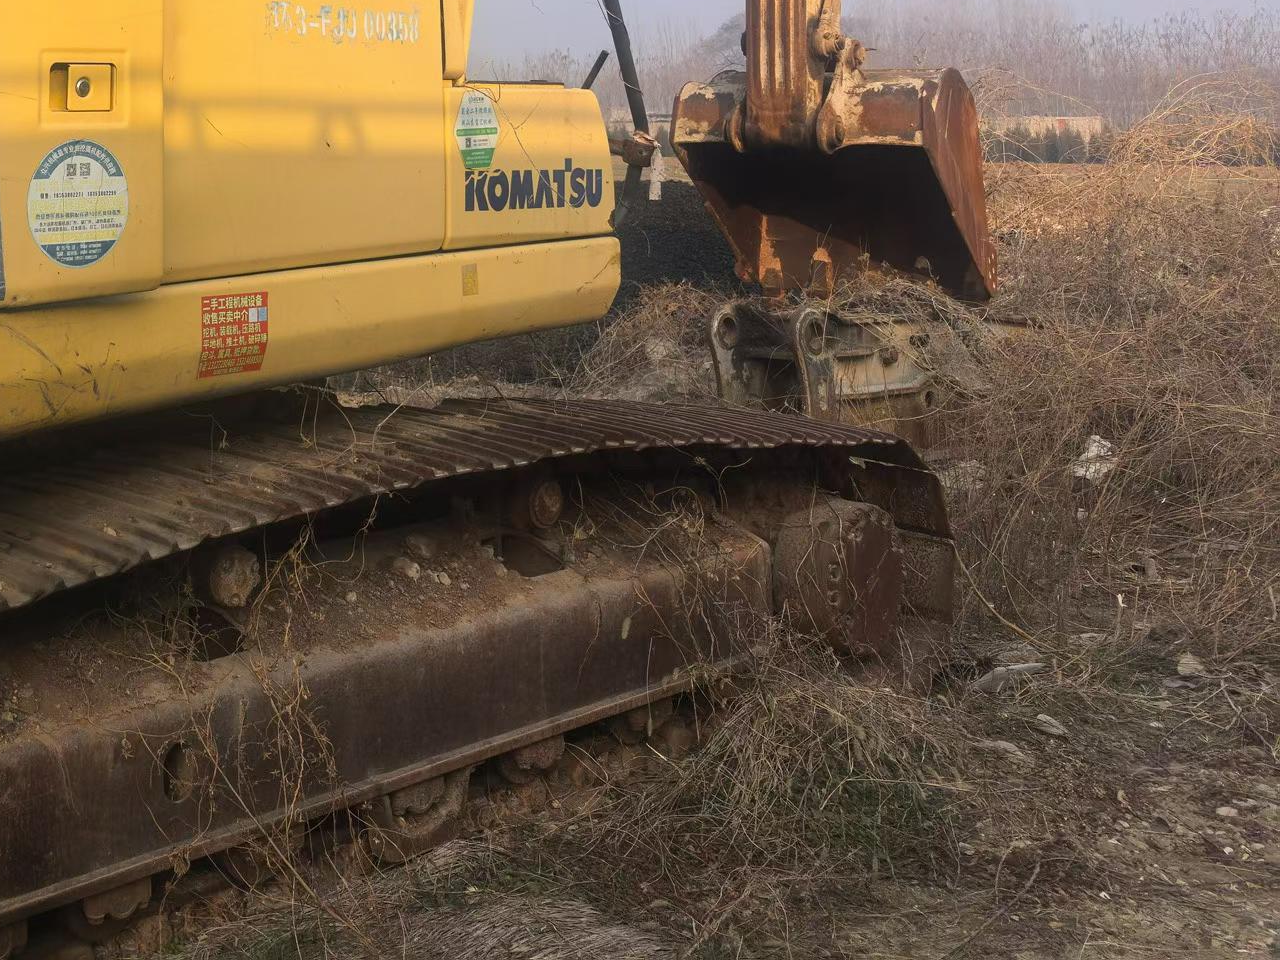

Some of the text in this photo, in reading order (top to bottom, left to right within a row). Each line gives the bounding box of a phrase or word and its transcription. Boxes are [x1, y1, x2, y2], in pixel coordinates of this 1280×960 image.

[464, 157, 603, 212] KOMATSU
[202, 294, 263, 311] 二手工程机械设备
[202, 309, 248, 326] 收售买卖中介
